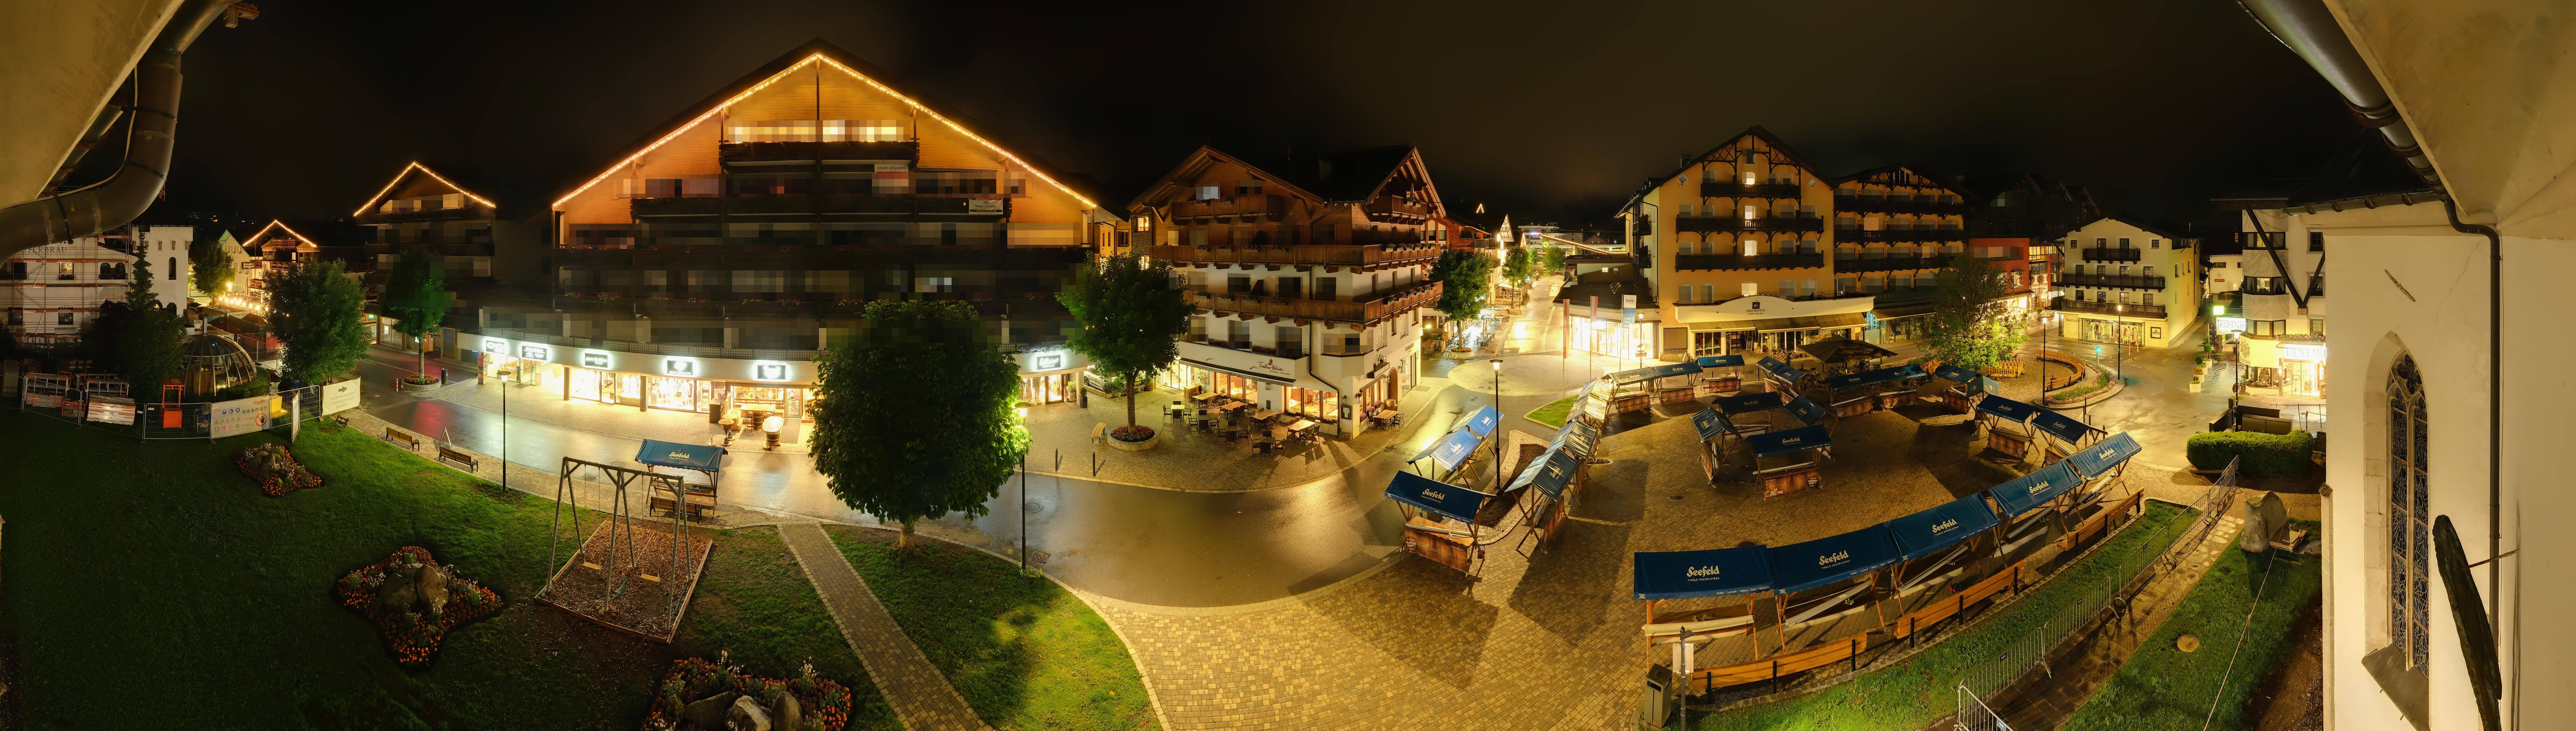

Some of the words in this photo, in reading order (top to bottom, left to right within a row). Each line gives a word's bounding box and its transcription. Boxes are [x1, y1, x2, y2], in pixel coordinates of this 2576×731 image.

[331, 396, 354, 405] KONGRESSZENTRUM
[2099, 448, 2115, 459] Seefeld
[2029, 480, 2049, 494] Seefeld
[1422, 489, 1445, 500] Seefeld
[1932, 518, 1957, 533] Seefeld
[1943, 525, 1959, 533] HOCHPLATEAU
[1819, 550, 1849, 565] Seefeld
[1687, 565, 1720, 577] Seefeld
